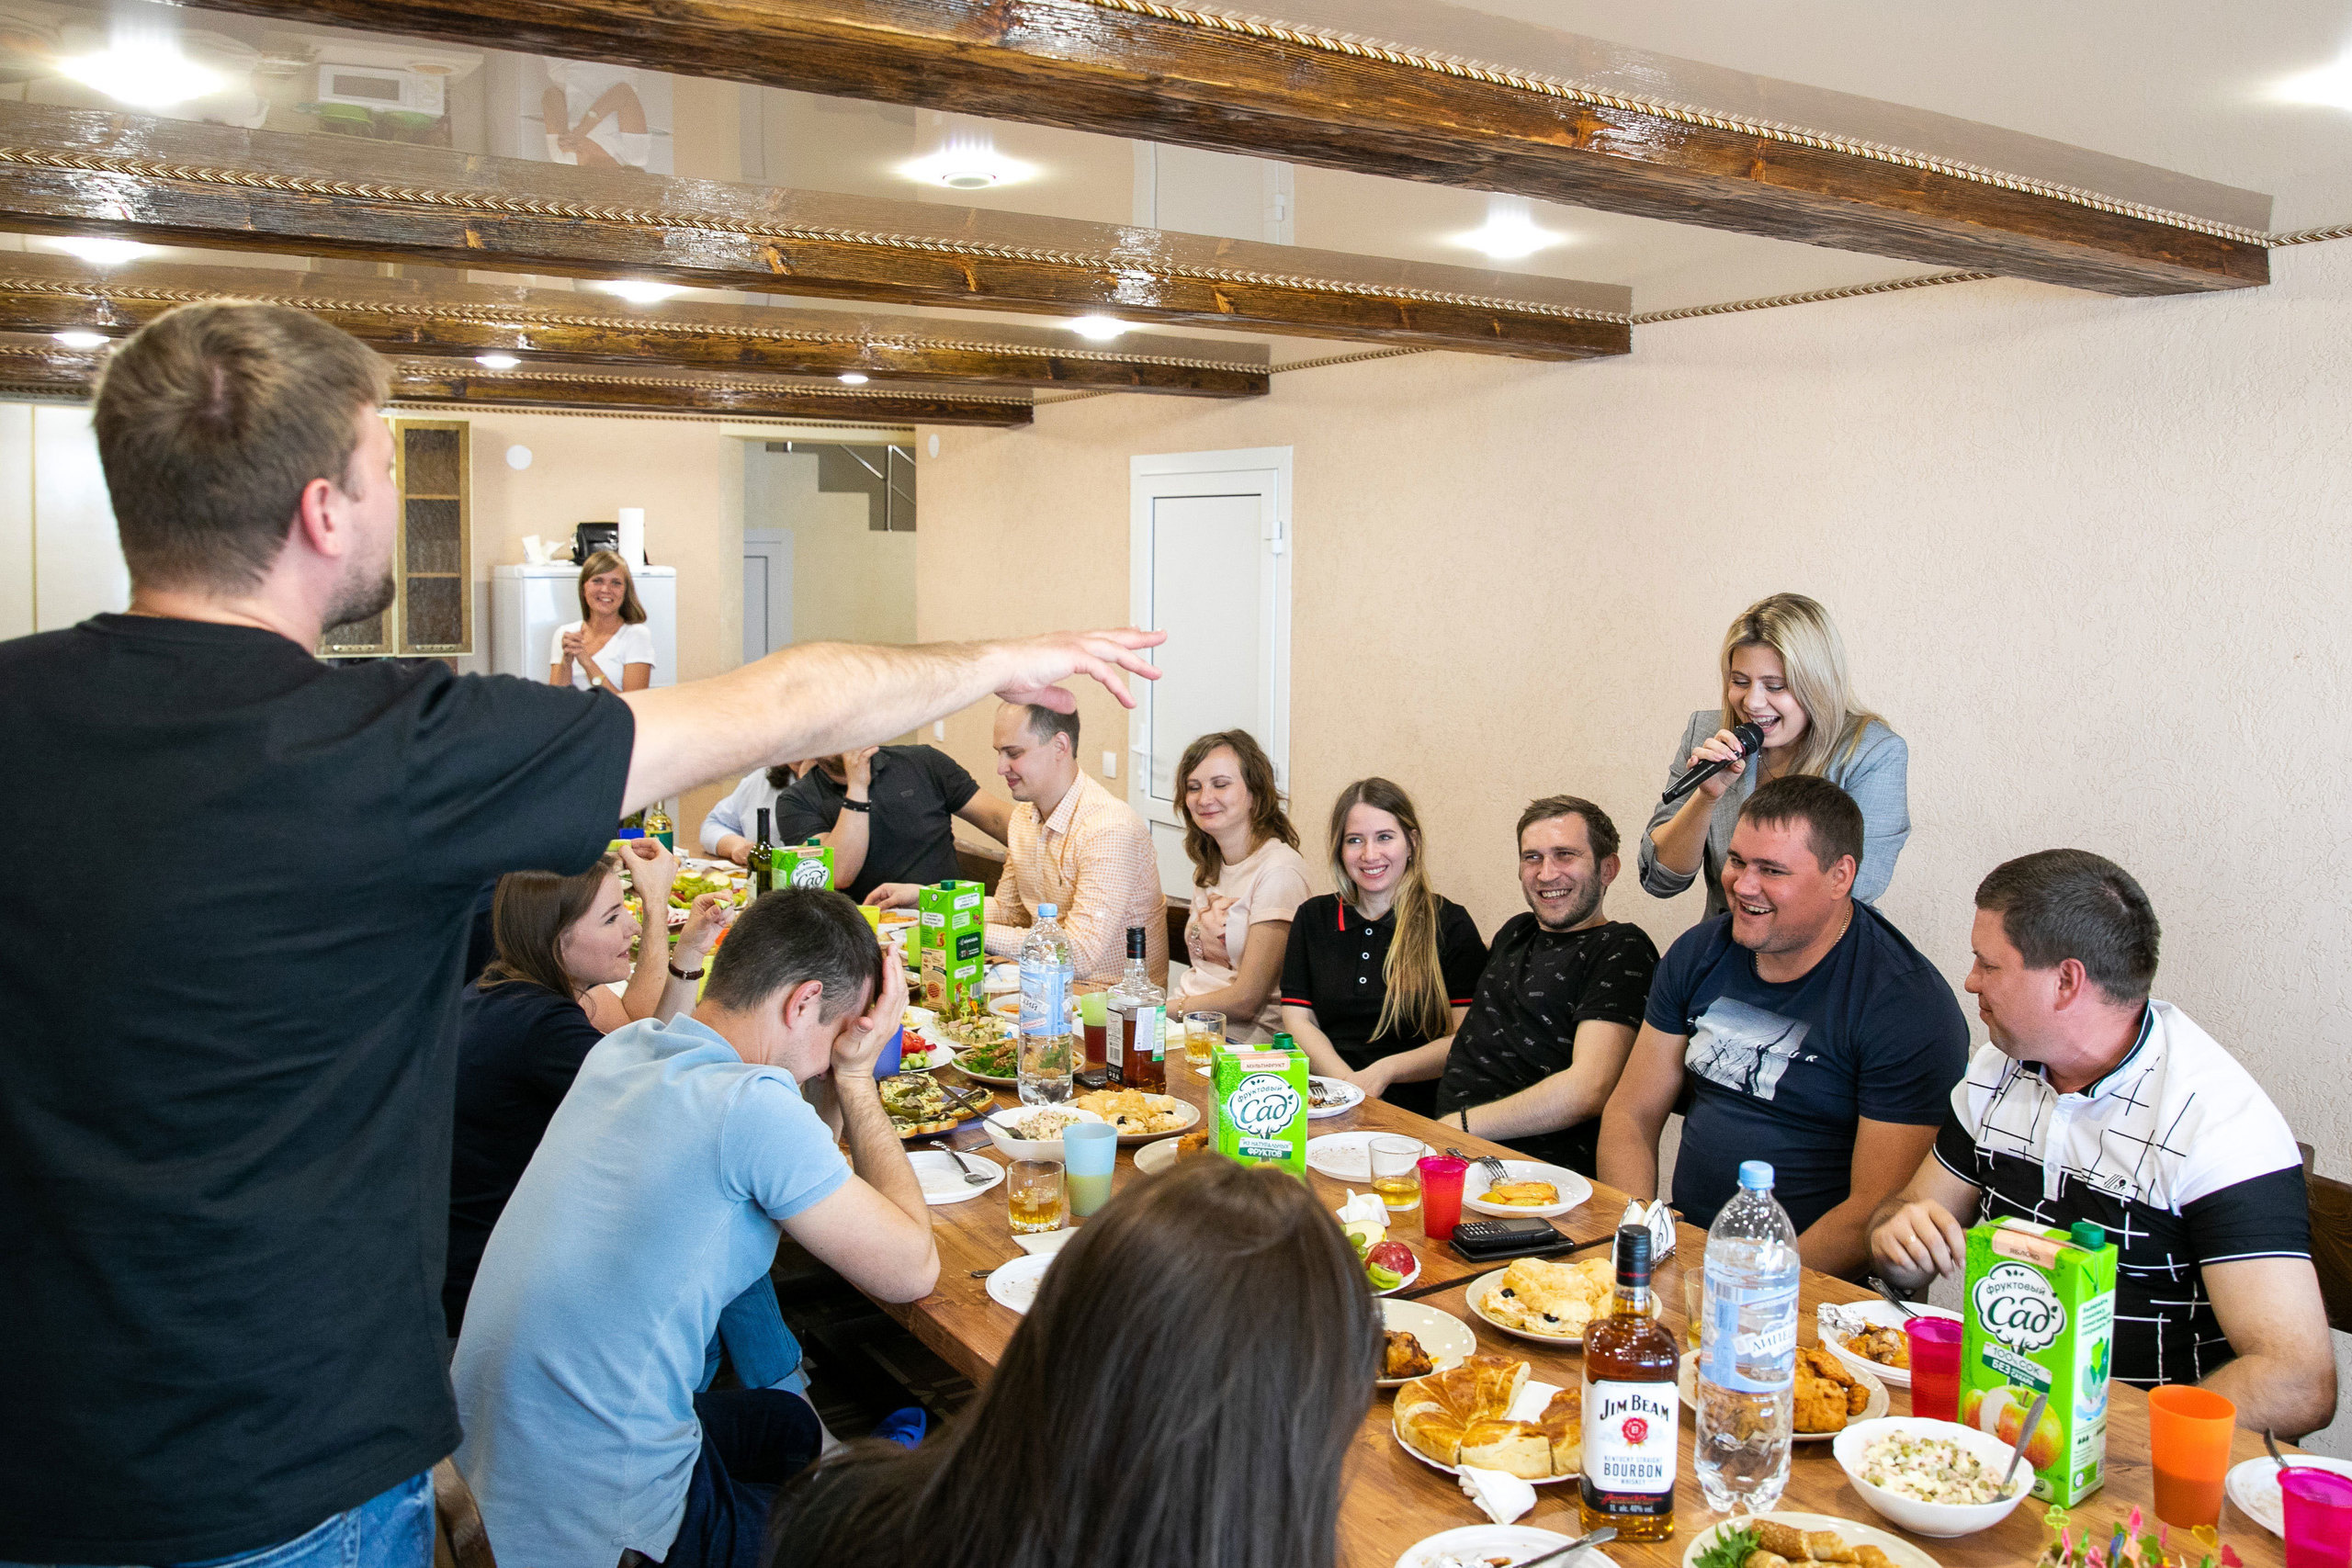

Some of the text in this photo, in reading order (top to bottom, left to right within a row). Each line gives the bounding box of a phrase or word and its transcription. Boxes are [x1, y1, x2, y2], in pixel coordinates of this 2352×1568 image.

[1237, 1085, 1283, 1103] фруктовый
[1239, 1094, 1288, 1124] Сад
[1247, 1148, 1283, 1158] ФРУКТОВ
[2008, 1247, 2041, 1261] ЯБЛОКО
[1985, 1281, 2046, 1296] фруктовый
[1987, 1296, 2051, 1334] Сад
[1991, 1359, 2011, 1376] БЕЗ
[1600, 1394, 1669, 1422] JIM BEAM
[1603, 1462, 1663, 1478] BOURBON
